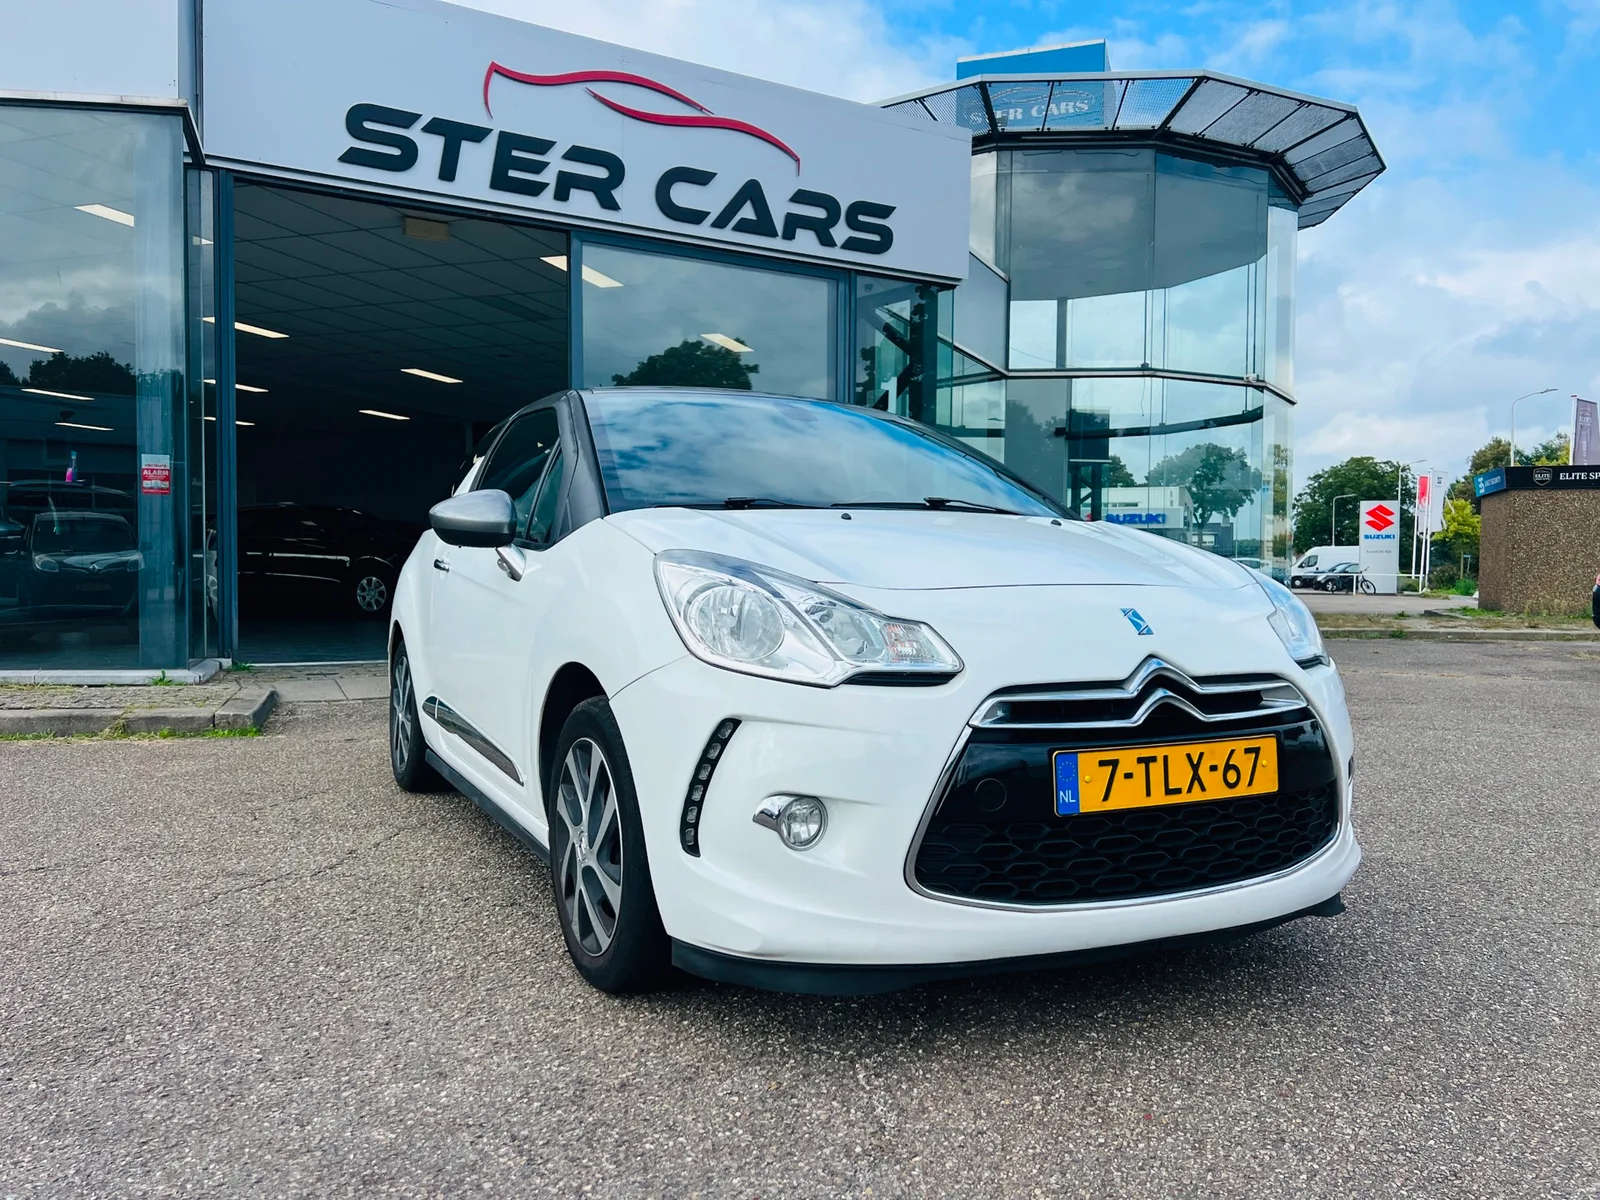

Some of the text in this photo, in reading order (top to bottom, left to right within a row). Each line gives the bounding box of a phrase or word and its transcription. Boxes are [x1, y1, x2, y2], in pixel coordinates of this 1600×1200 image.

[969, 100, 1089, 125] SER CARS
[337, 102, 897, 255] STER CARS
[1559, 472, 1588, 480] ELITE
[1105, 513, 1166, 524] SUZUKI
[1098, 746, 1261, 802] 7-TLX-67
[1059, 789, 1077, 804] NL
